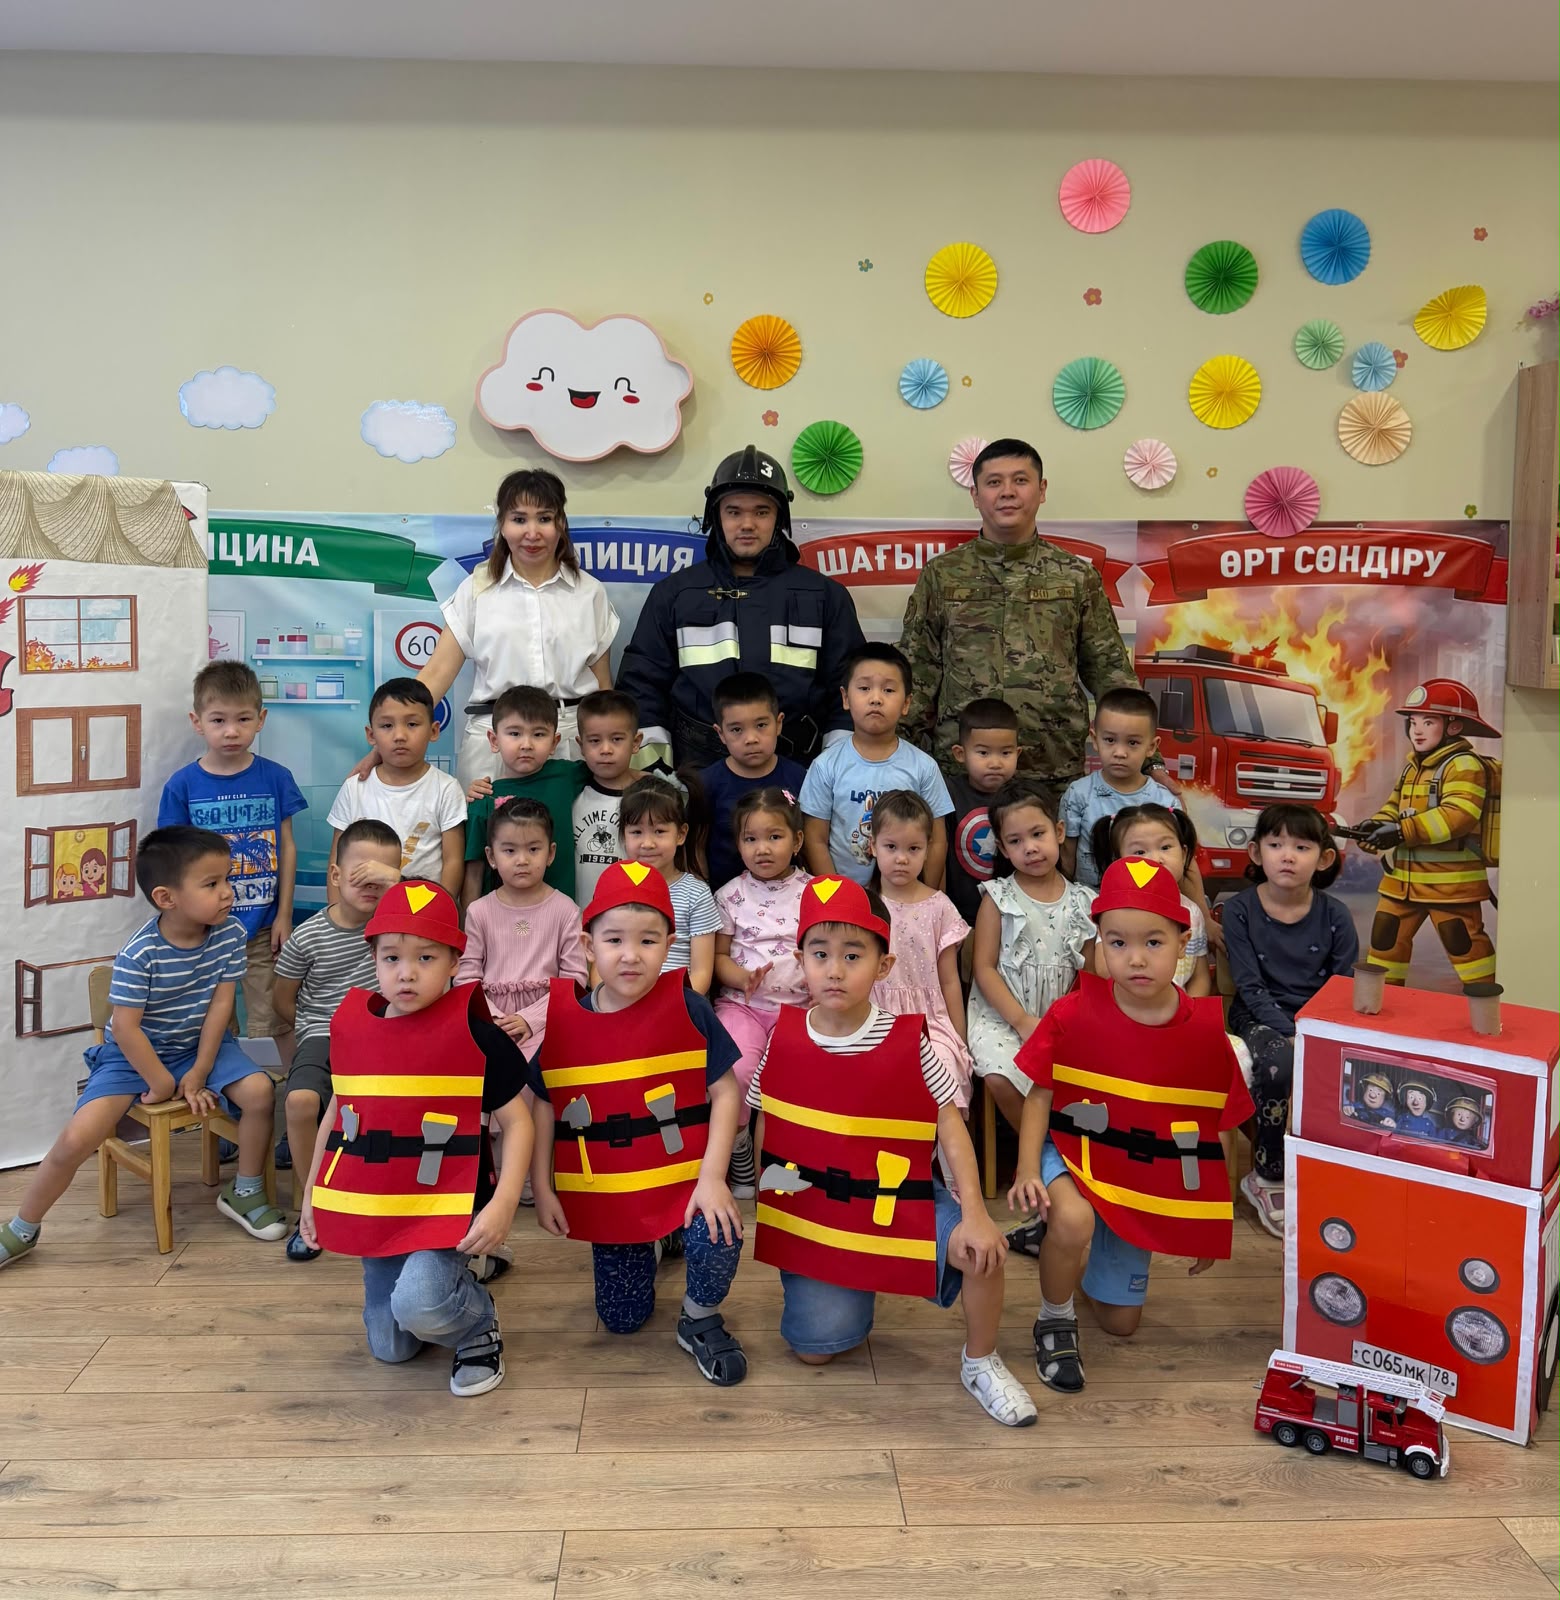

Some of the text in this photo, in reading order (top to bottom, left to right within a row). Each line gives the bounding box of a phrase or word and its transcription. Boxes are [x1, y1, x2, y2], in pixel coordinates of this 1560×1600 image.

[760, 461, 774, 479] 3
[1220, 545, 1447, 579] ӨРТ СӨНДІРУ
[407, 635, 437, 656] 60
[195, 803, 268, 825] SOUTH
[582, 810, 608, 827] TIME
[588, 855, 613, 863] 1984
[1433, 1368, 1450, 1385] 78
[1335, 1435, 1355, 1445] FIRE
